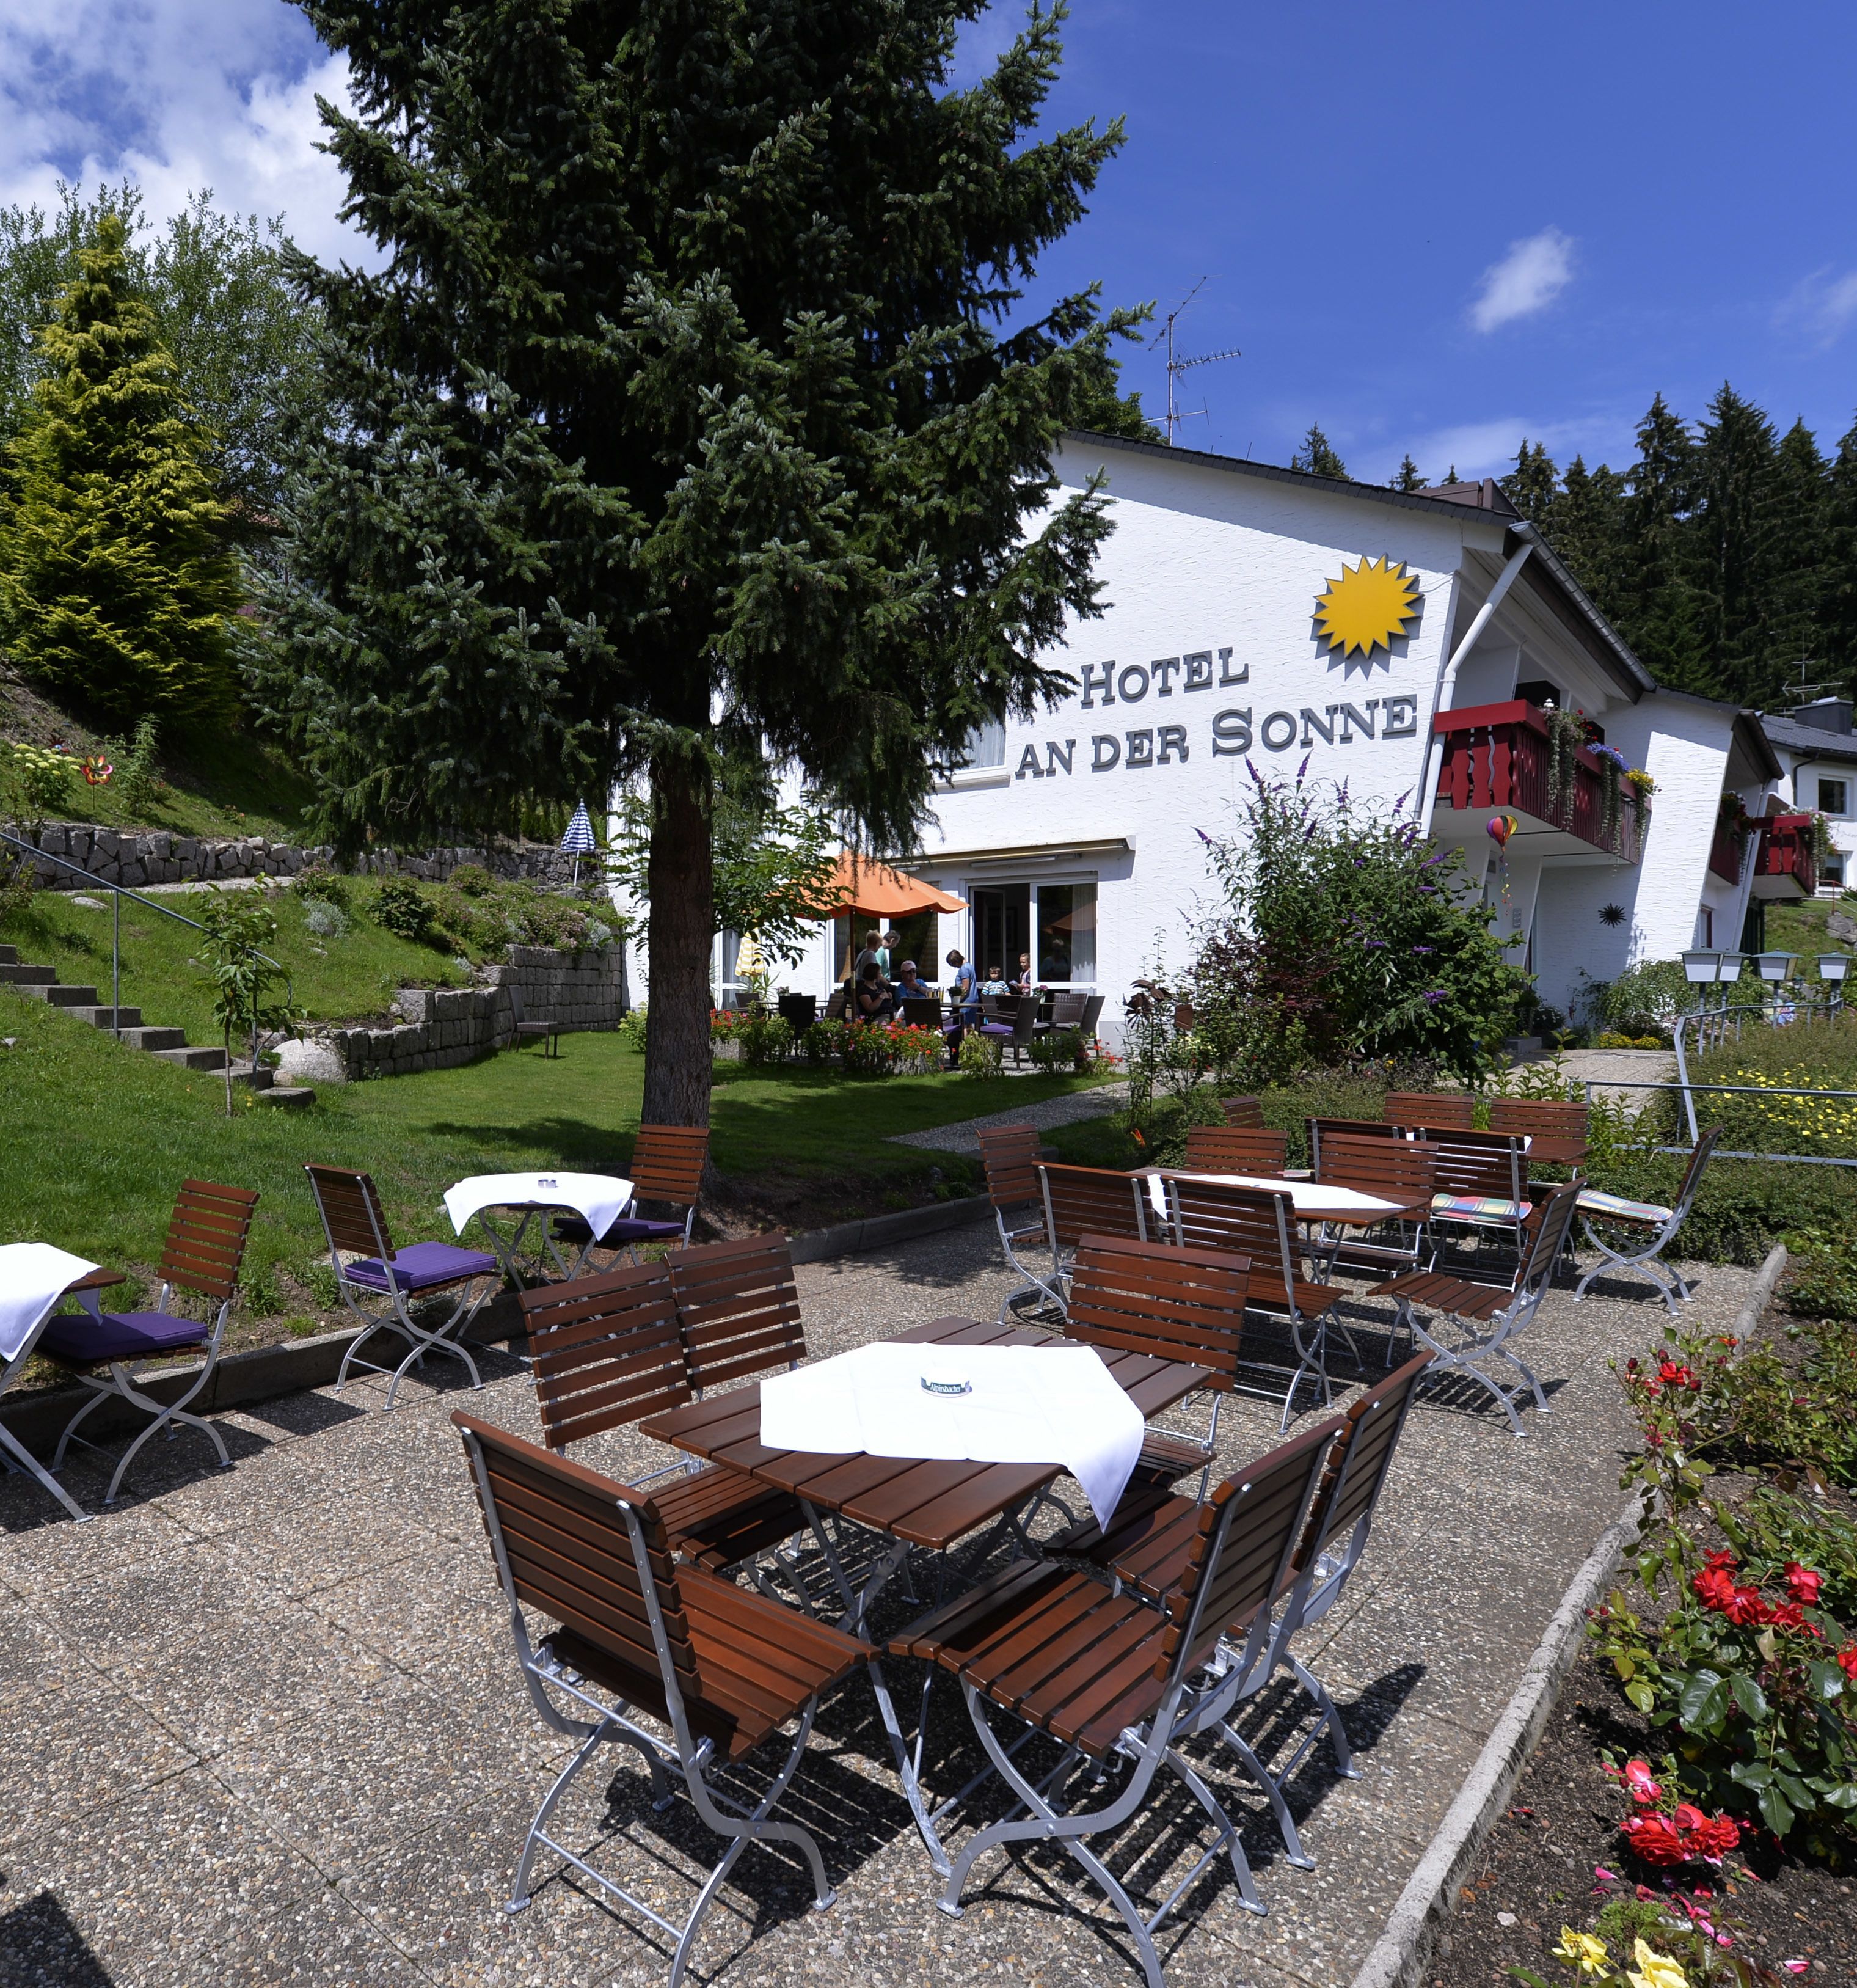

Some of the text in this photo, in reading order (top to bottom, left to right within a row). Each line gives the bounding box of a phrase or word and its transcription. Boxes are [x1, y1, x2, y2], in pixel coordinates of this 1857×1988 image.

[1081, 647, 1249, 707] HOTEL
[1015, 694, 1417, 778] AN DER SONNE
